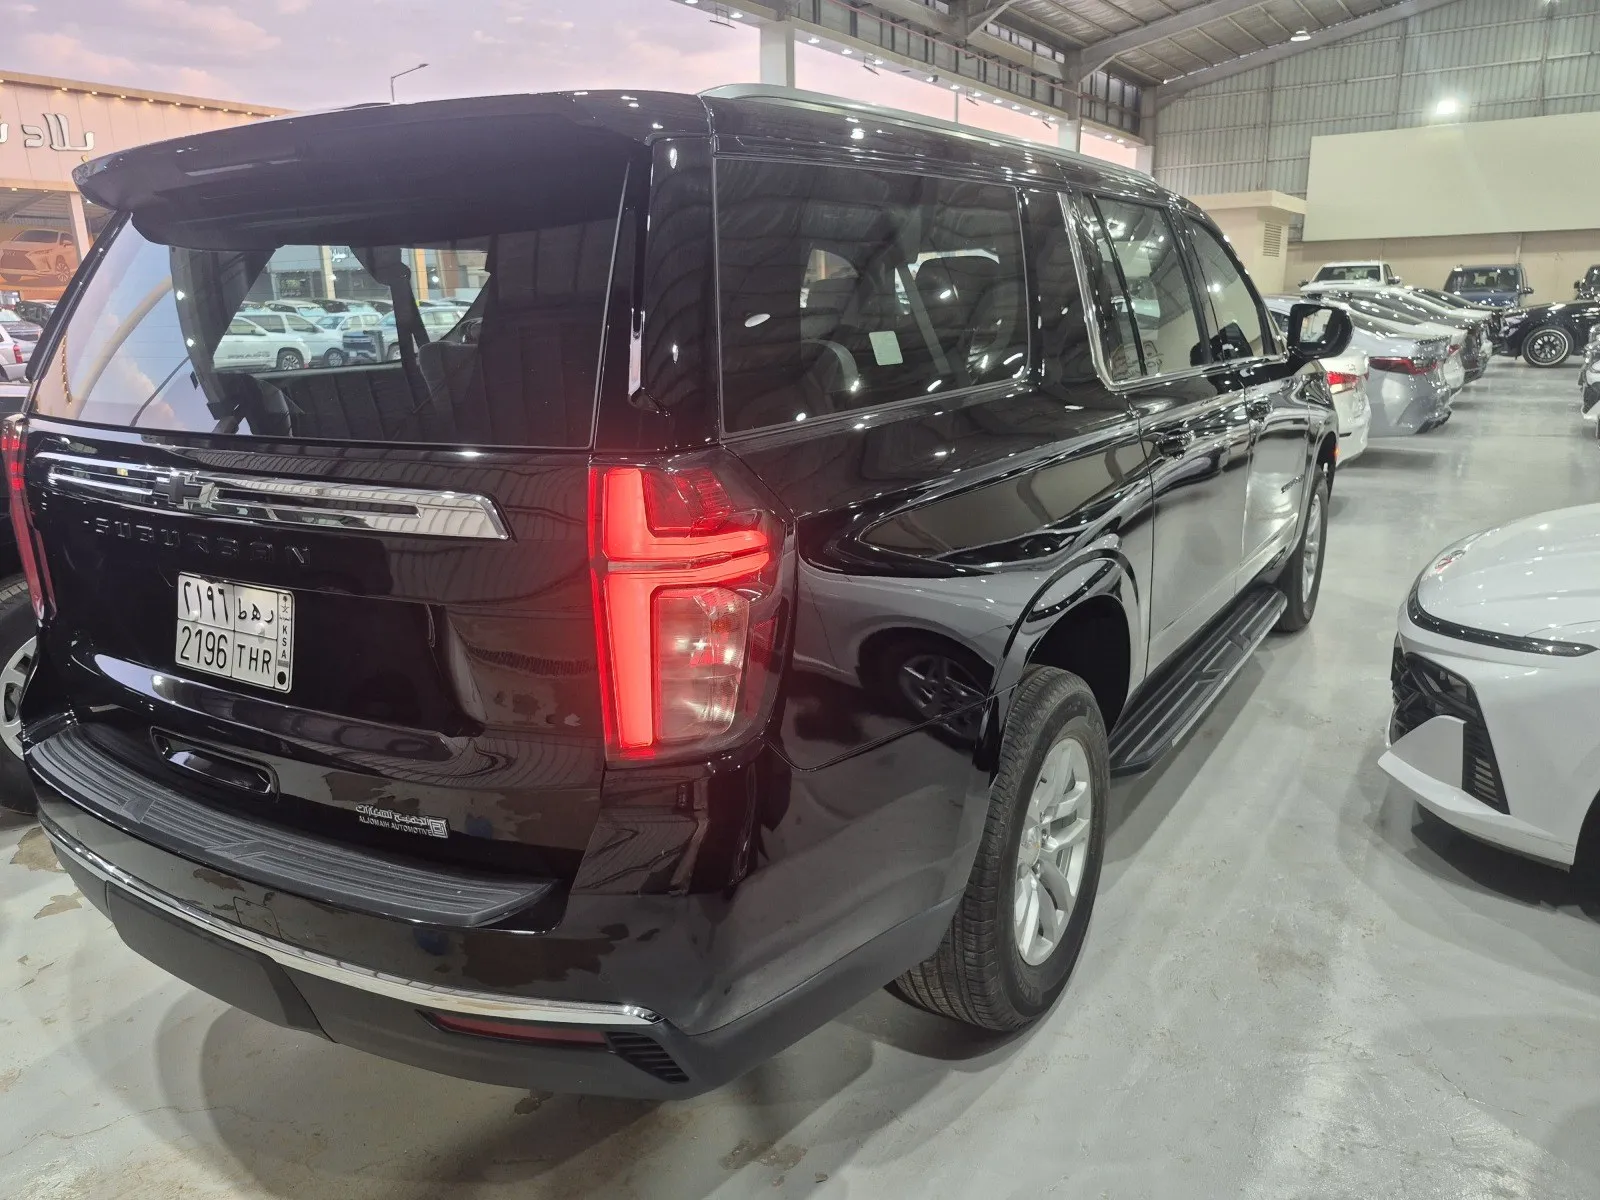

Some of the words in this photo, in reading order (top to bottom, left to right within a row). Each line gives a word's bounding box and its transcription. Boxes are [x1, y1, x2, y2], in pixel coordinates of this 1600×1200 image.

[95, 516, 311, 565] SUBURBAN
[183, 581, 229, 625] ٢١٩٦
[180, 625, 228, 669] 2196
[237, 643, 272, 674] THR
[280, 625, 288, 659] KSA
[391, 822, 433, 836] AUTOMOTIVE
